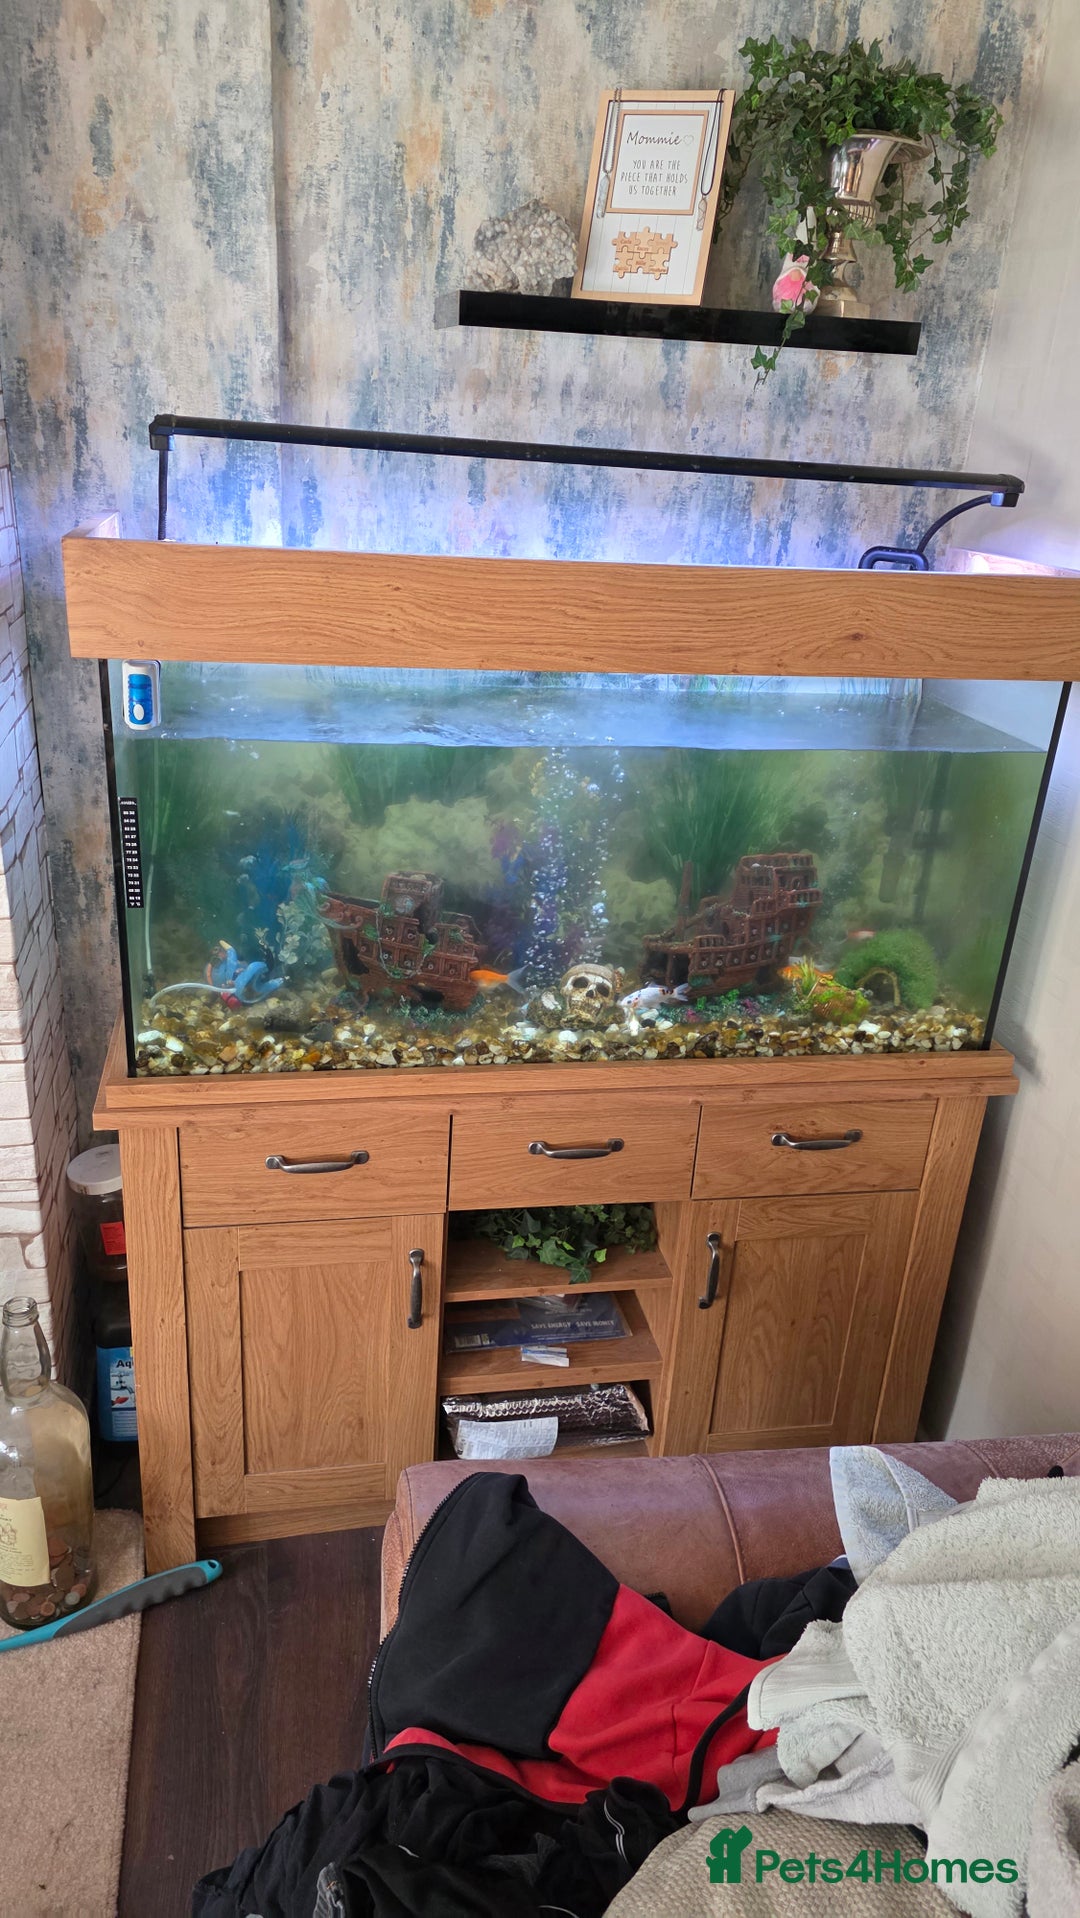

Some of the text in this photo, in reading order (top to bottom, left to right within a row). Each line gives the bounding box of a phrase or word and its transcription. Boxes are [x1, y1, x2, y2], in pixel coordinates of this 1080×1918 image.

[626, 130, 682, 146] Mommie
[633, 159, 681, 170] YOU ARE THE
[620, 171, 688, 184] PIECE THAT HOLDS
[628, 185, 678, 196] US TOGETHER
[115, 1359, 134, 1369] Aq
